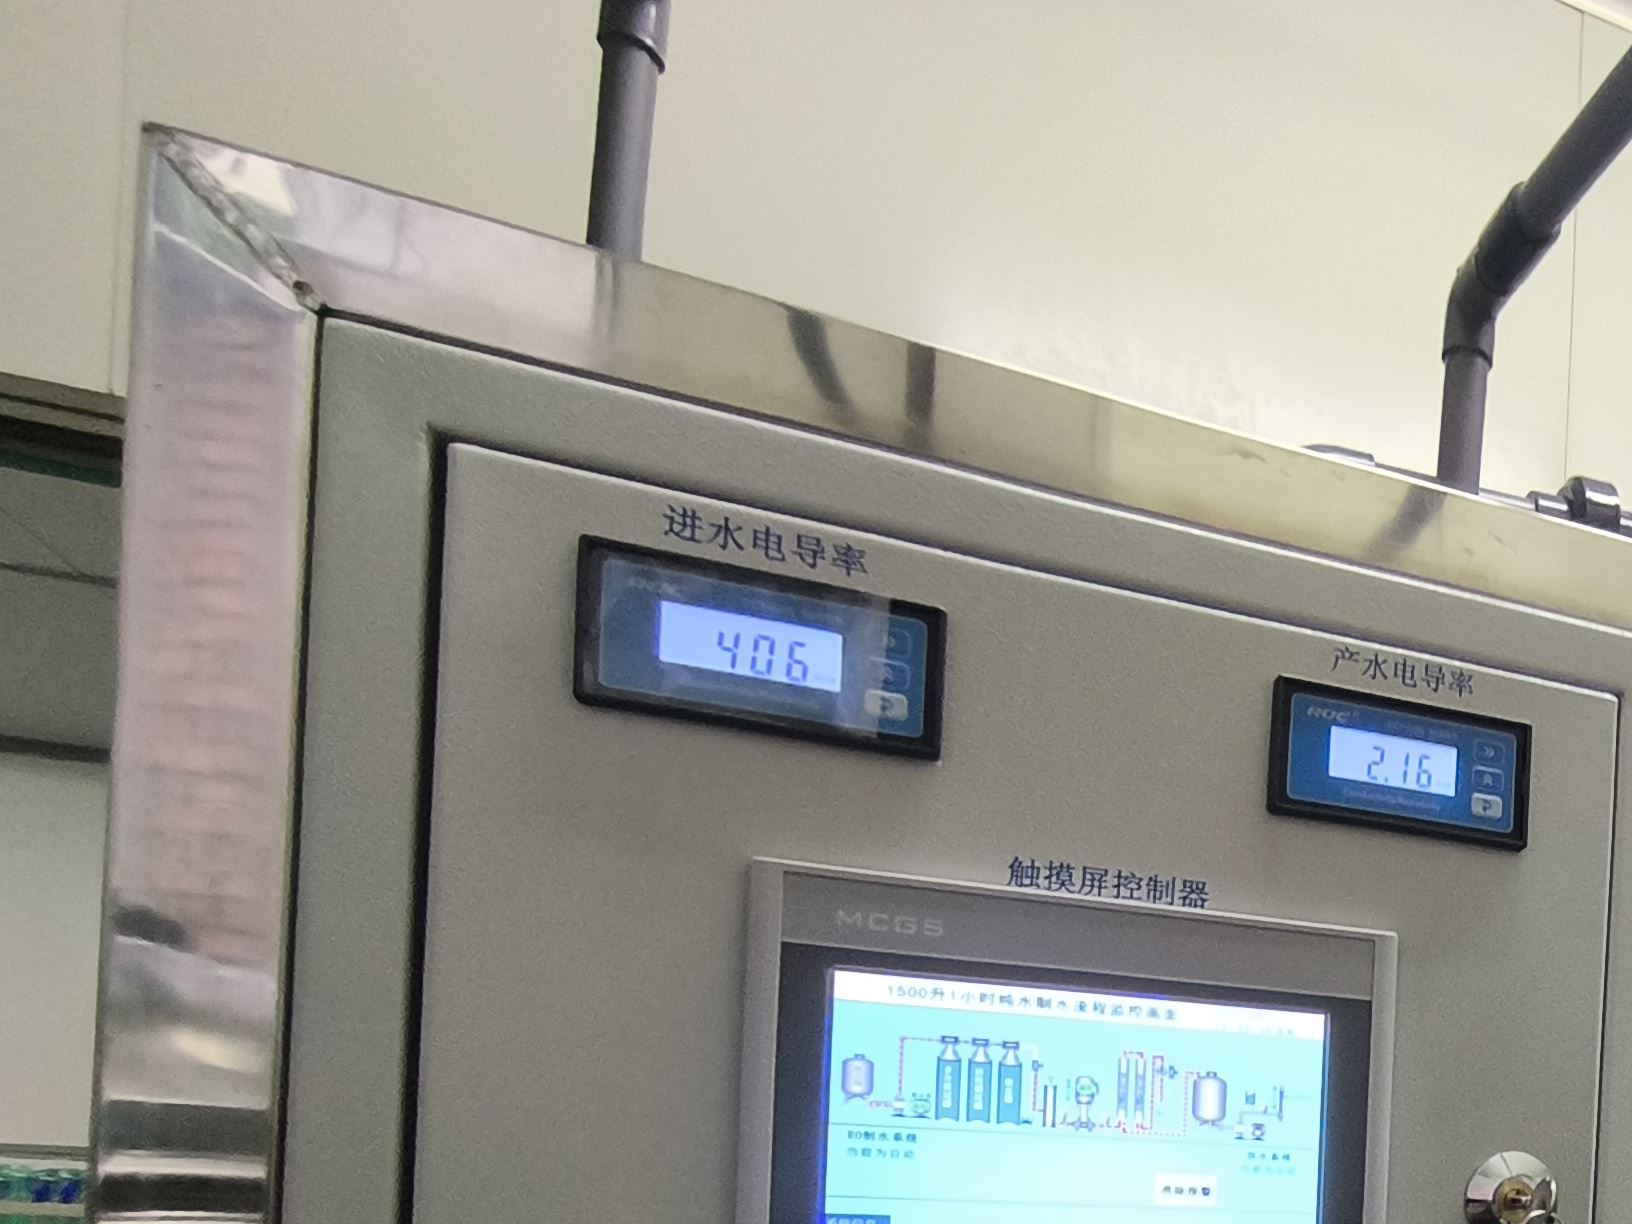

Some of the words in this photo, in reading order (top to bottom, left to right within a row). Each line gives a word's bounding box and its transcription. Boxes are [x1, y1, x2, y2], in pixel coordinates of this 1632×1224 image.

[661, 504, 869, 577] 进水电导率
[716, 629, 810, 683] 406
[1331, 646, 1474, 697] 产水电导率
[1366, 745, 1433, 789] 2.16
[1006, 855, 1211, 909] 触摸屏控制器
[837, 908, 943, 936] MCGS
